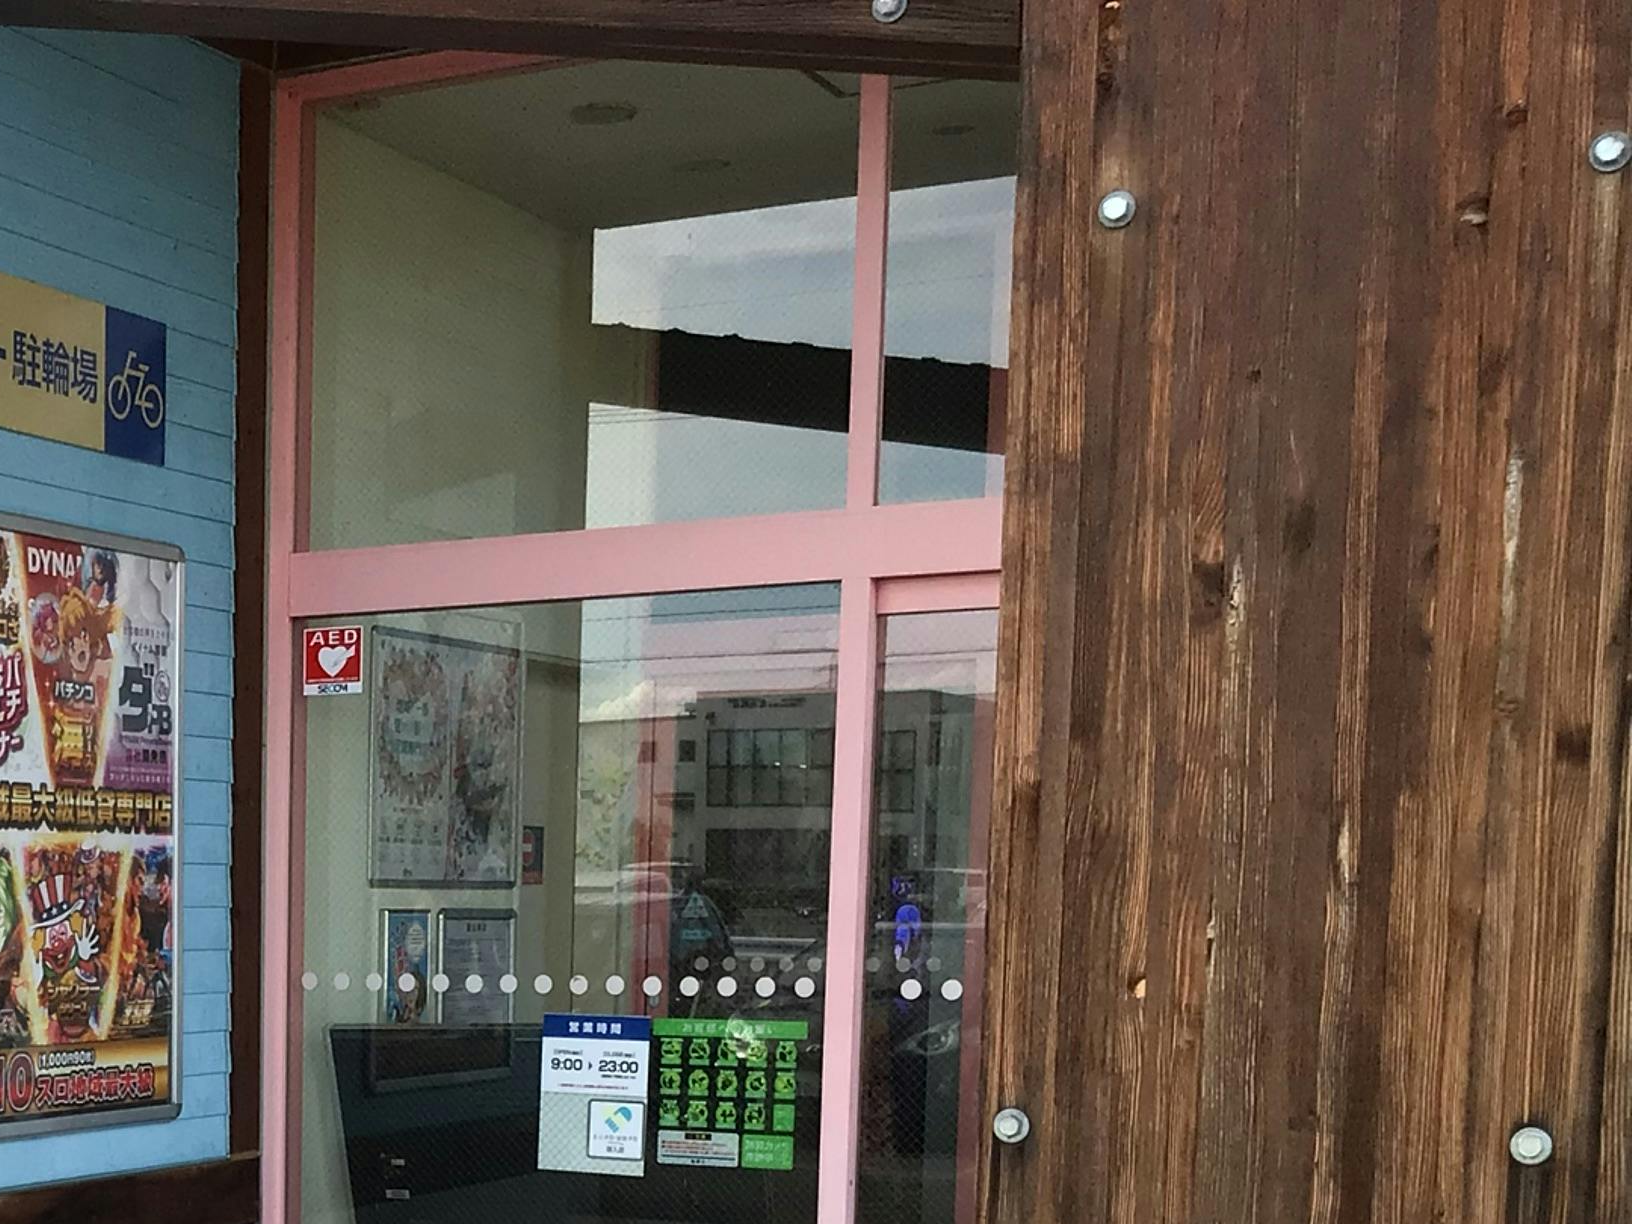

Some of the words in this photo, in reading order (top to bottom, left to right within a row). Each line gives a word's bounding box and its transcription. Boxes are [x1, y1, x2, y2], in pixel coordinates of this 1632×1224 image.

[12, 330, 98, 404] 駐輪場
[28, 546, 82, 578] DYNA
[309, 630, 357, 646] AED
[54, 680, 95, 700] パチンコ
[568, 1020, 623, 1035] 営業時間
[551, 1058, 583, 1071] 9:00
[598, 1060, 639, 1074] 23:00
